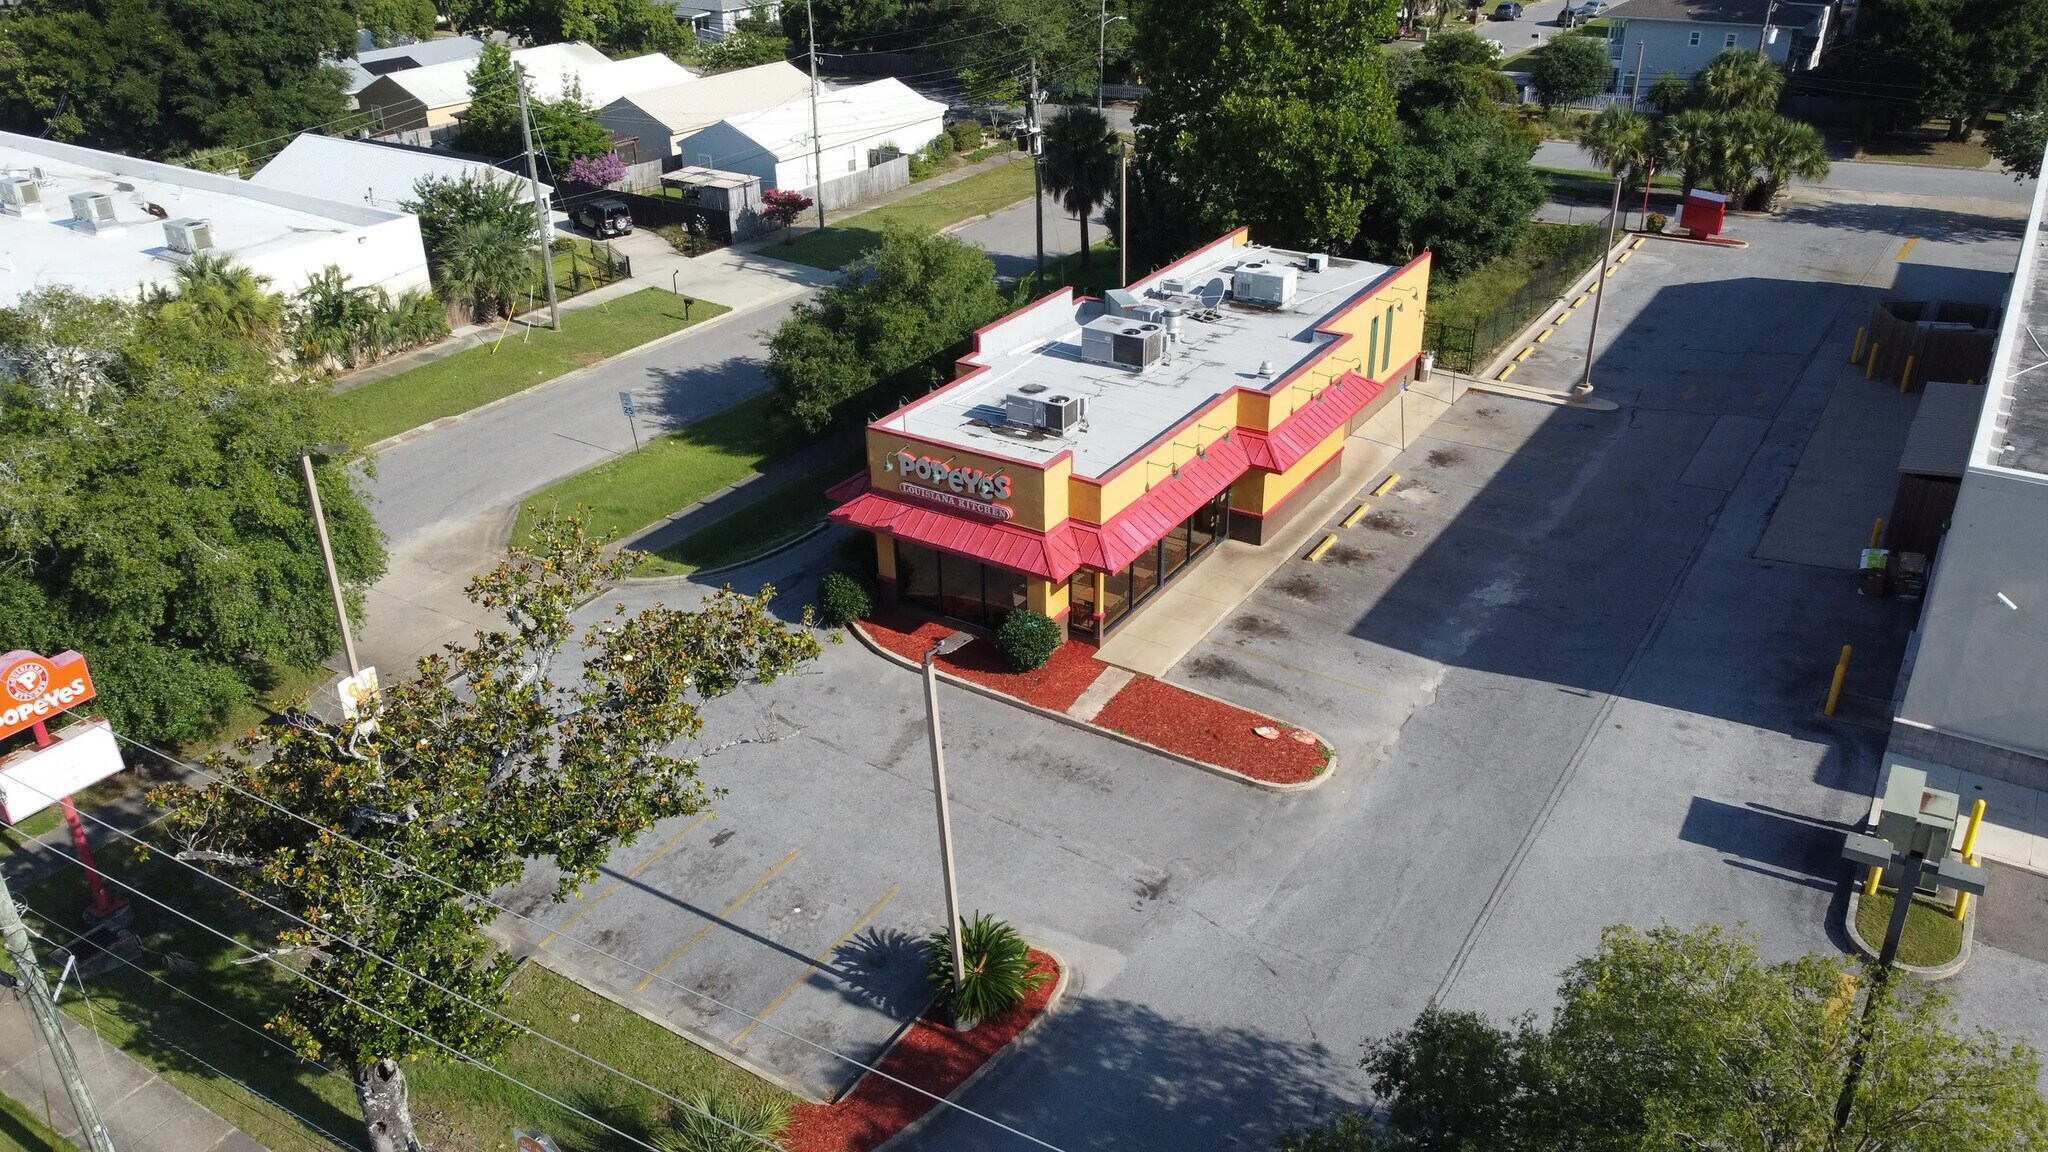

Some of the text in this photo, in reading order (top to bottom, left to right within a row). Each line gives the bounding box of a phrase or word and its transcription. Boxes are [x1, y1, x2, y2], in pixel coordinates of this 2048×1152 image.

[623, 406, 634, 415] 25
[902, 484, 1007, 519] LOUISIANA KITCHEN
[16, 670, 37, 691] P
